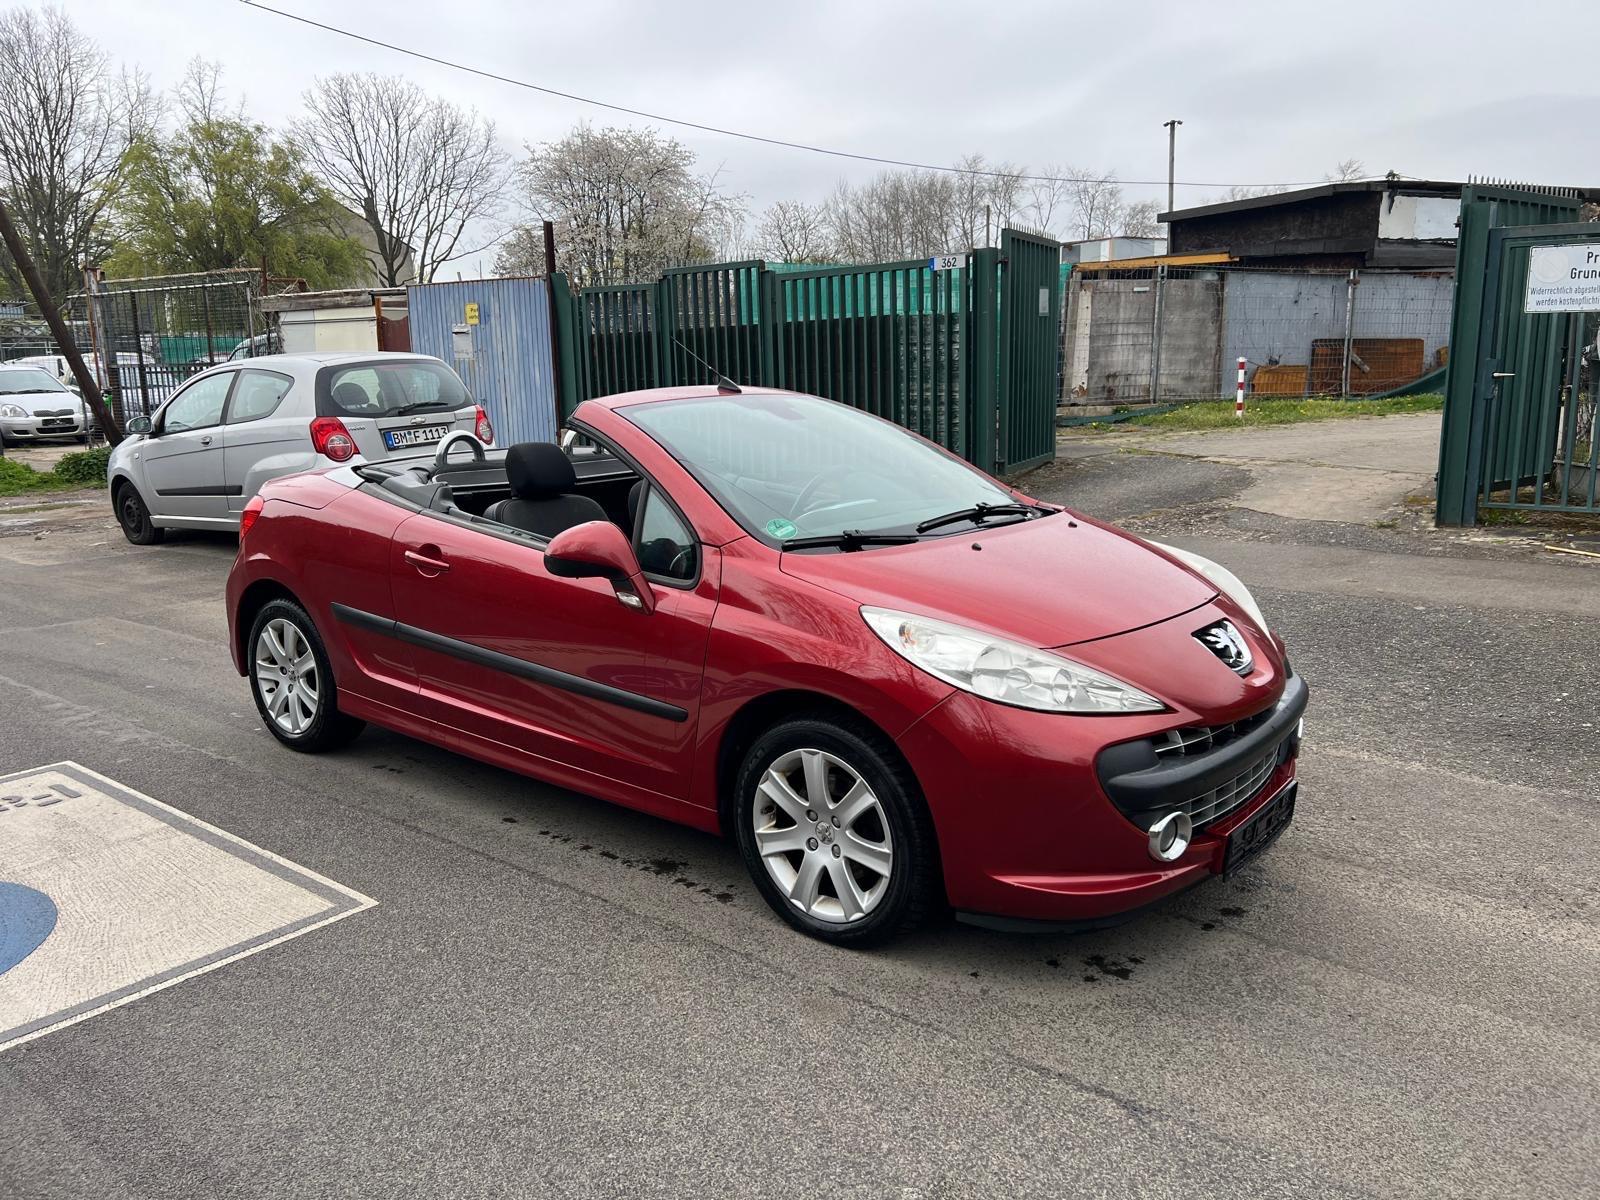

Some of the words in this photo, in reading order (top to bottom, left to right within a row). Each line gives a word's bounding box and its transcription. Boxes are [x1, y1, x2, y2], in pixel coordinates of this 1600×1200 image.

[942, 257, 957, 268] 362
[1587, 252, 1600, 264] Pr
[1531, 286, 1573, 296] Widerrechtlich
[1536, 298, 1558, 306] werden
[393, 432, 408, 445] BM
[413, 430, 421, 442] F
